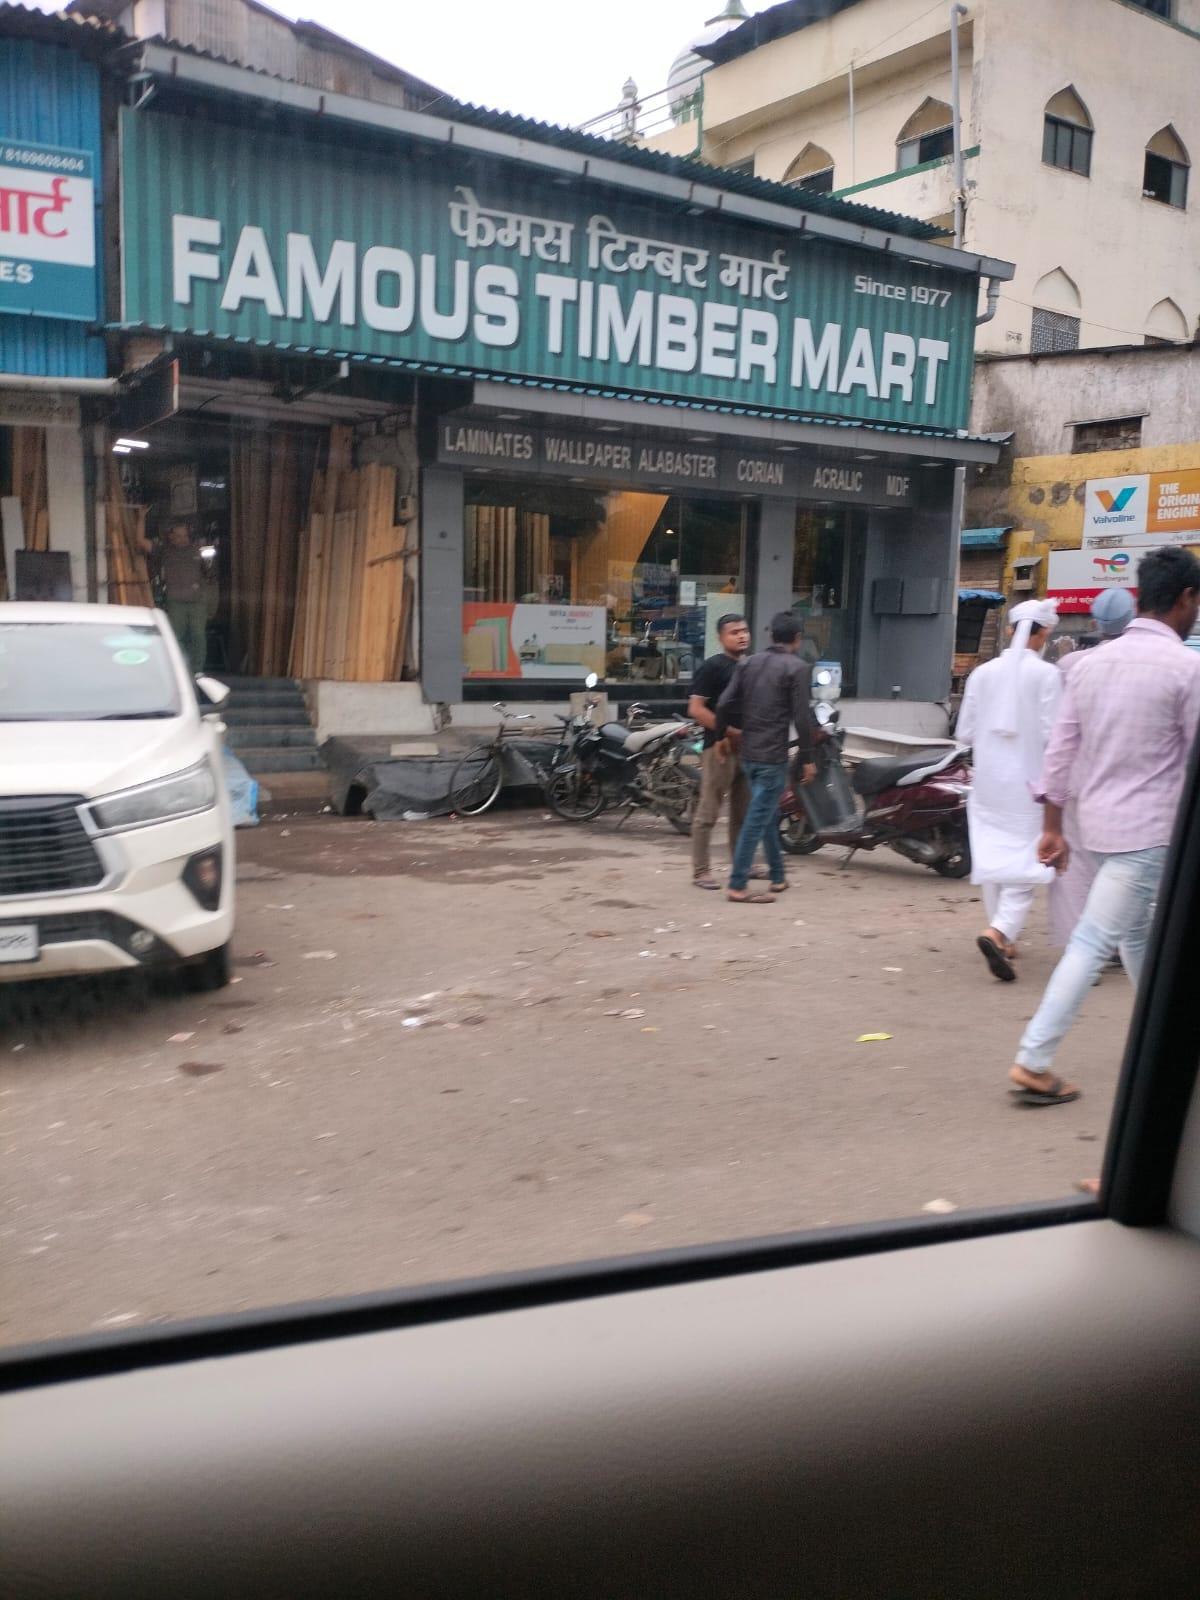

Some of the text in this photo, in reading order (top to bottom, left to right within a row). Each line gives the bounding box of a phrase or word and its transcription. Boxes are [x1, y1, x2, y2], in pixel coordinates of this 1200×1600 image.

[448, 185, 790, 301] फेमस टिम्बर मार्ट
[854, 274, 952, 308] Since 1977
[172, 213, 950, 406] FAMOUS TIMBER MART
[444, 426, 911, 497] LAMINATES WALLPAPER ALABASTER CORIAN ACRALIC MDF
[1159, 483, 1180, 495] THE
[1093, 514, 1135, 525] Valvoline
[1157, 505, 1199, 520] ENGINE
